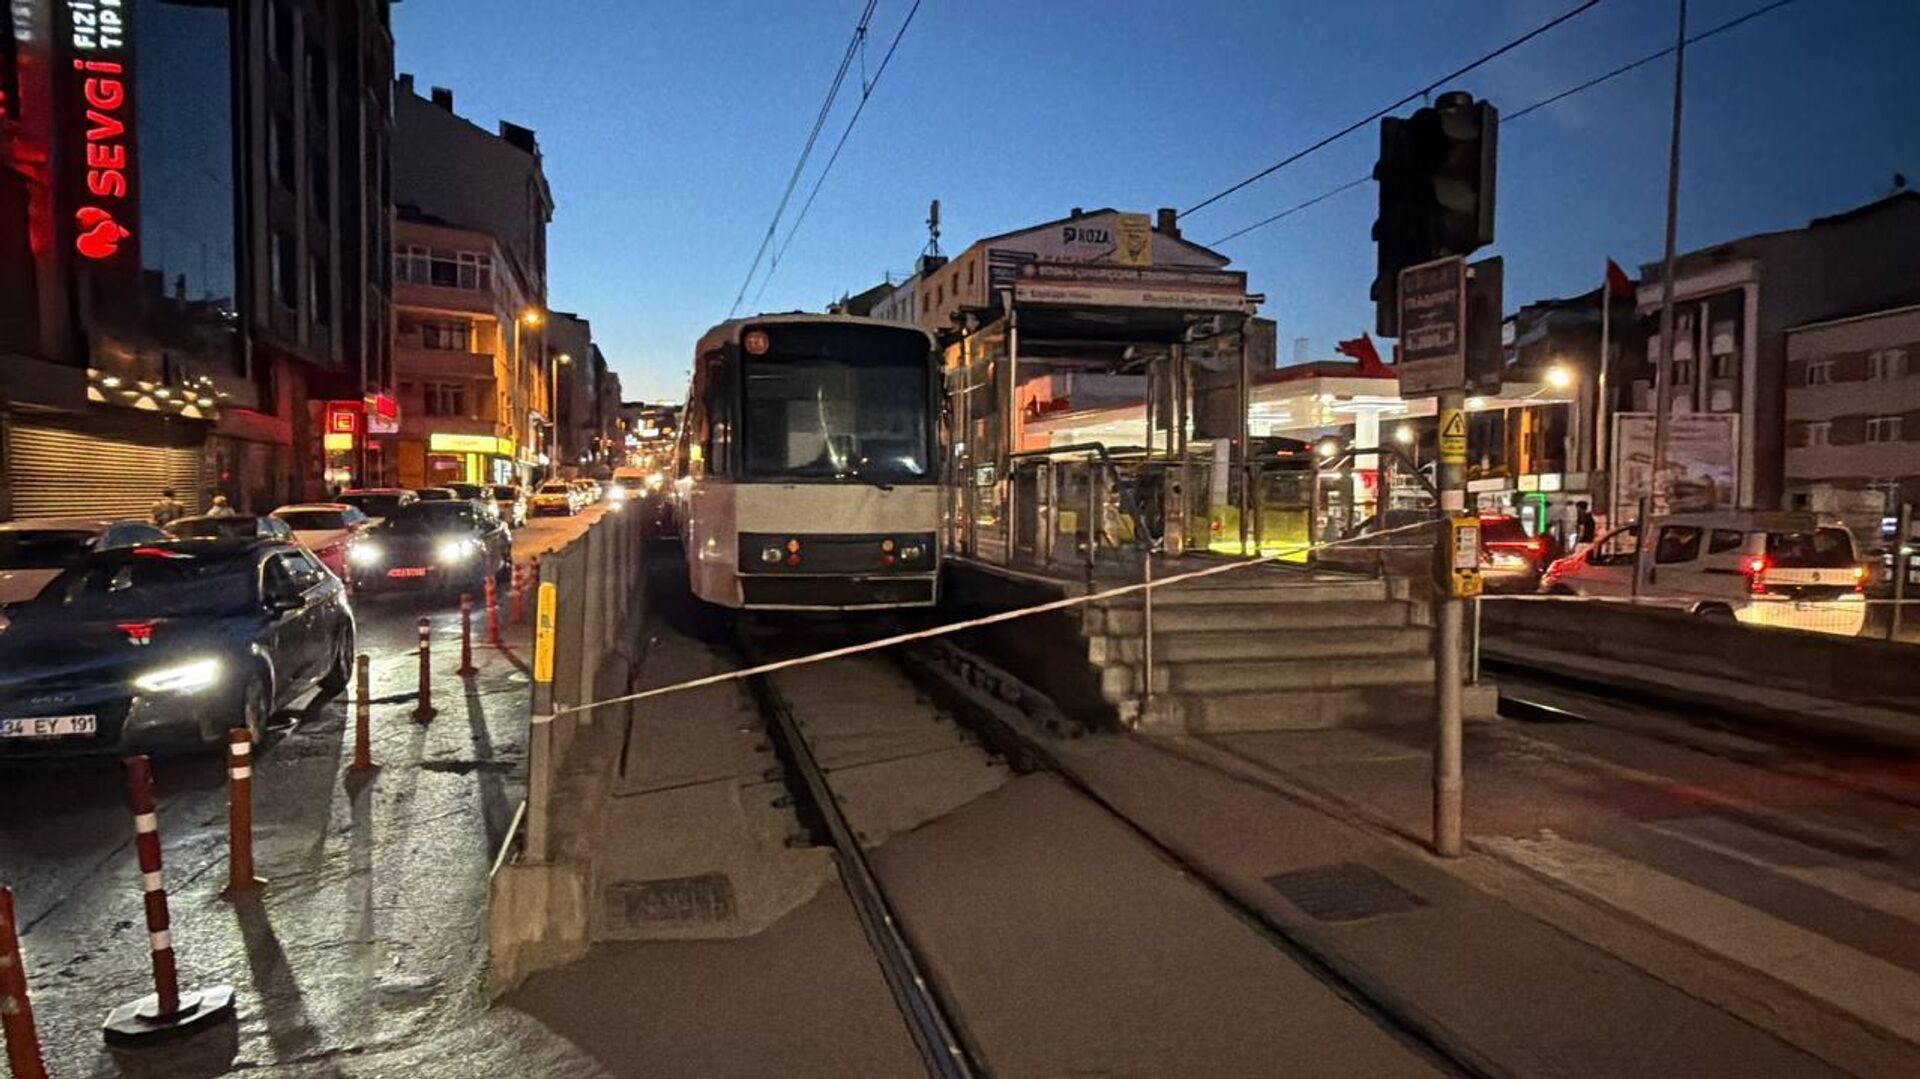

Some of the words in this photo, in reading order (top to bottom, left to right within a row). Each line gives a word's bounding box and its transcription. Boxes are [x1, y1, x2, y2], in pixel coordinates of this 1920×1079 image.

[3, 720, 24, 735] 34
[34, 718, 57, 734] EY
[70, 716, 95, 732] 191
